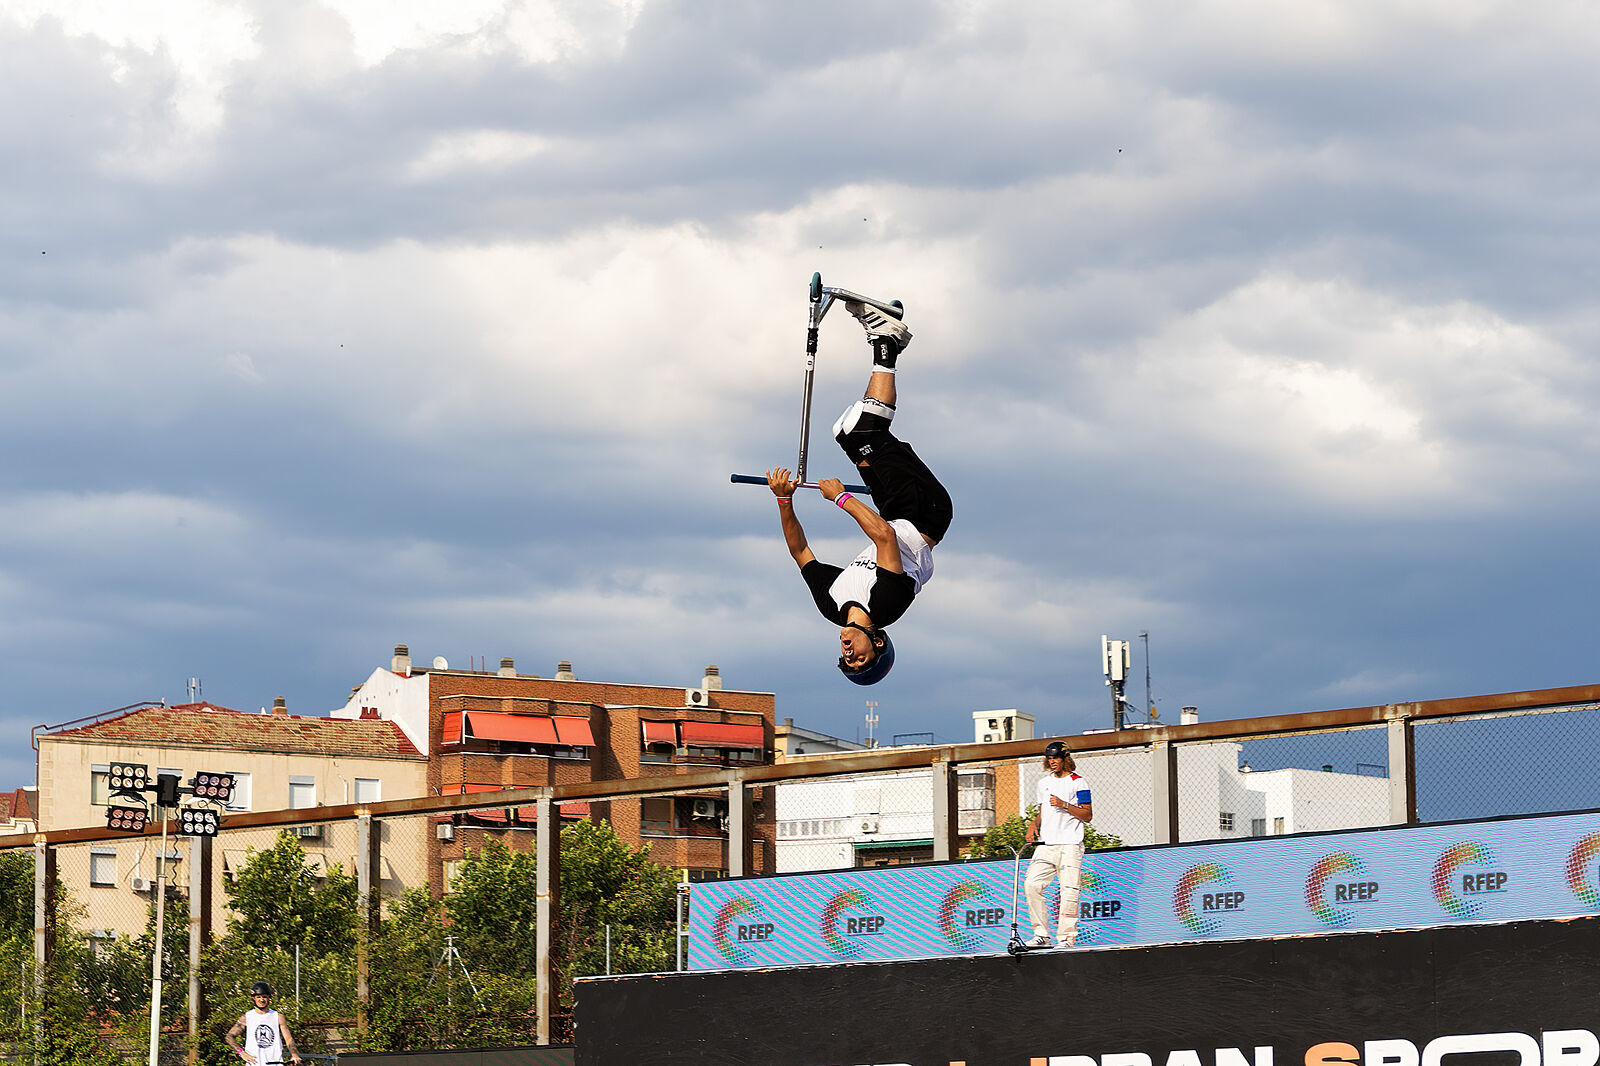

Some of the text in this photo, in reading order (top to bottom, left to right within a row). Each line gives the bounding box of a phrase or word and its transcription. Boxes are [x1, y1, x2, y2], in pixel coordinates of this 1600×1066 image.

[1336, 882, 1379, 900] RFEP
[1463, 873, 1508, 891] RFEP
[1080, 901, 1121, 919] RFEP
[1203, 892, 1245, 911] RFEP
[848, 916, 885, 933] RFEP
[965, 908, 1004, 926] RFEP
[739, 924, 775, 941] RFEP
